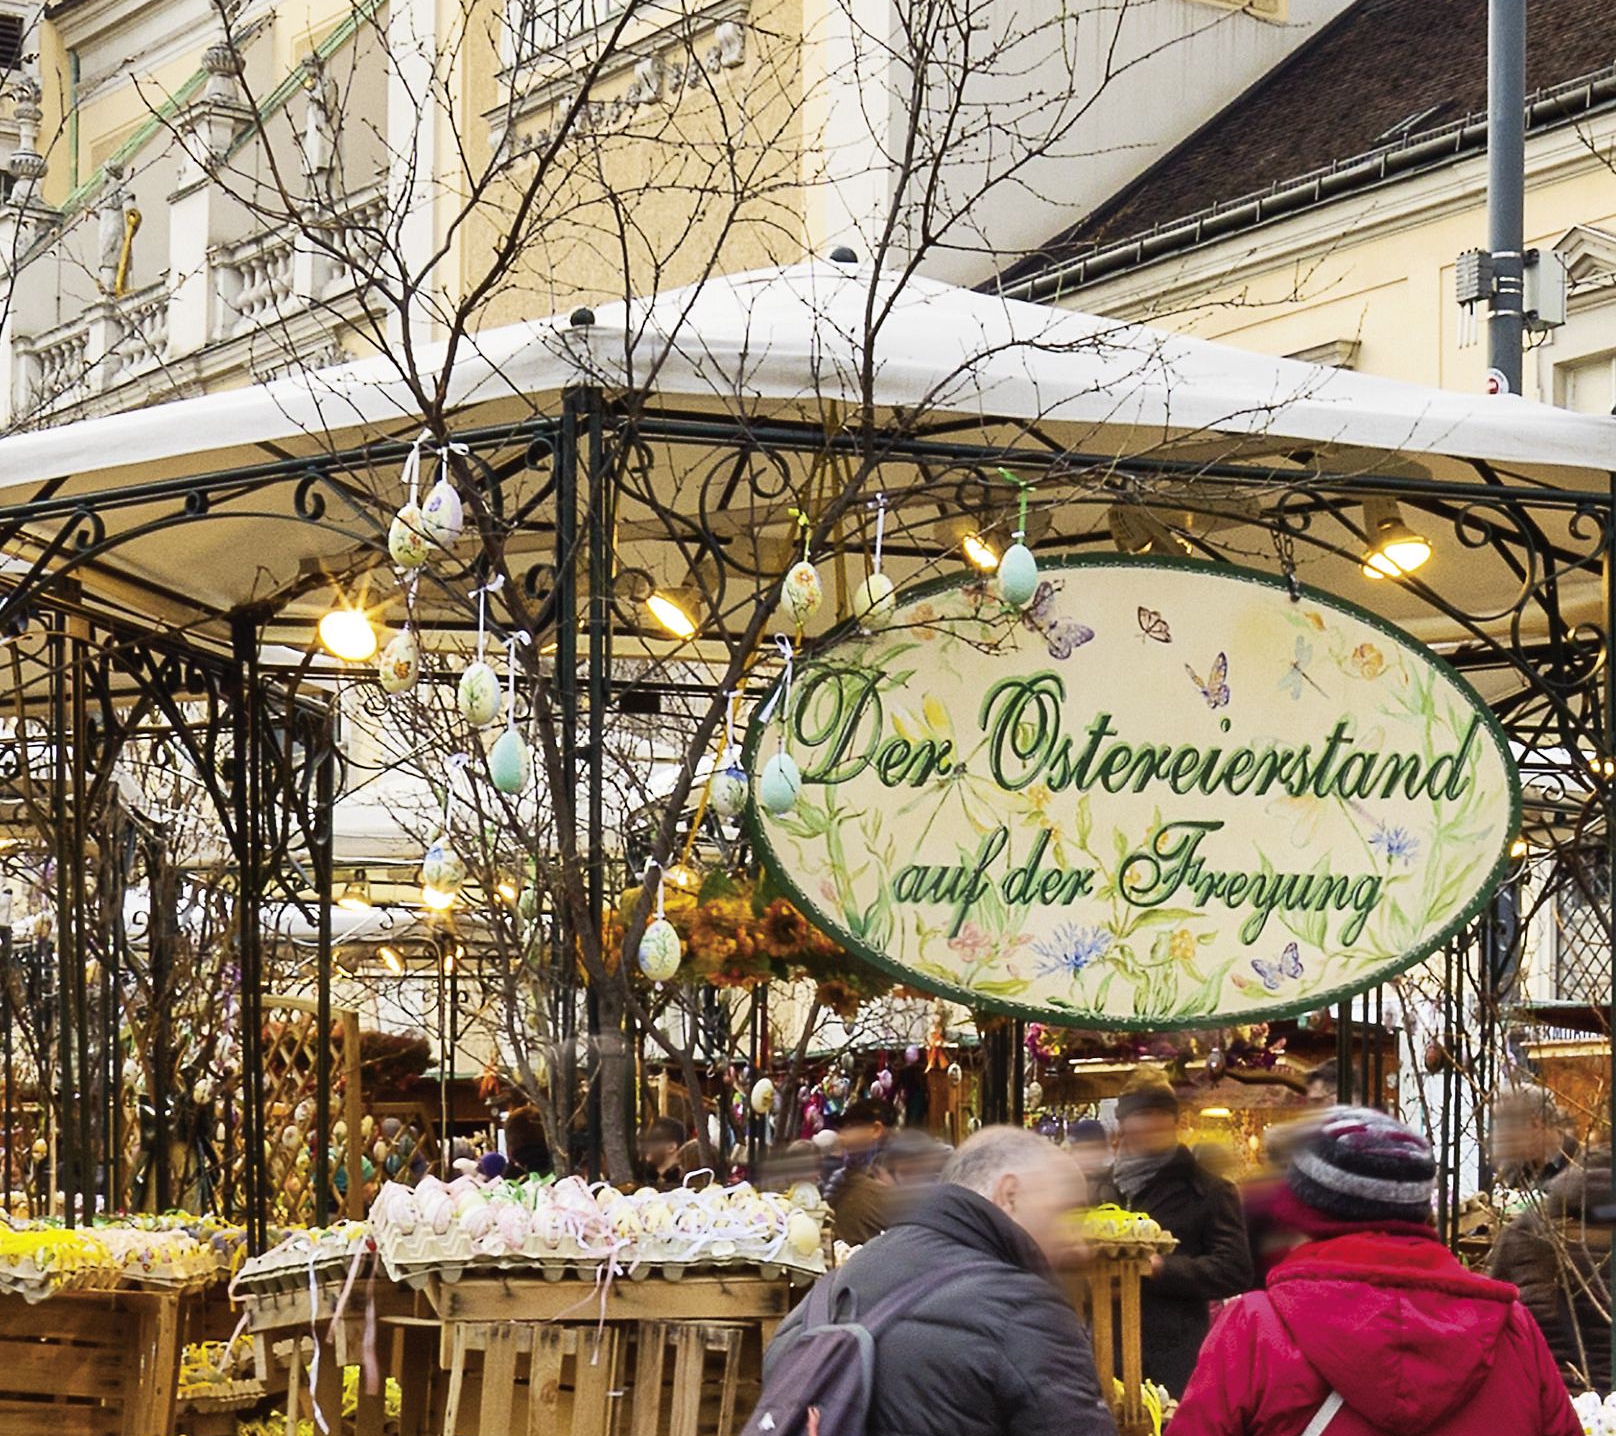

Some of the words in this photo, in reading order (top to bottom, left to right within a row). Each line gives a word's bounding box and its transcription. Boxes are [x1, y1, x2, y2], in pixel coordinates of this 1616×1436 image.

[795, 664, 954, 785] Der
[980, 671, 1482, 802] Ostereierstand
[892, 824, 1009, 940] auf
[1003, 826, 1095, 908] der
[1117, 820, 1384, 947] Freyung
